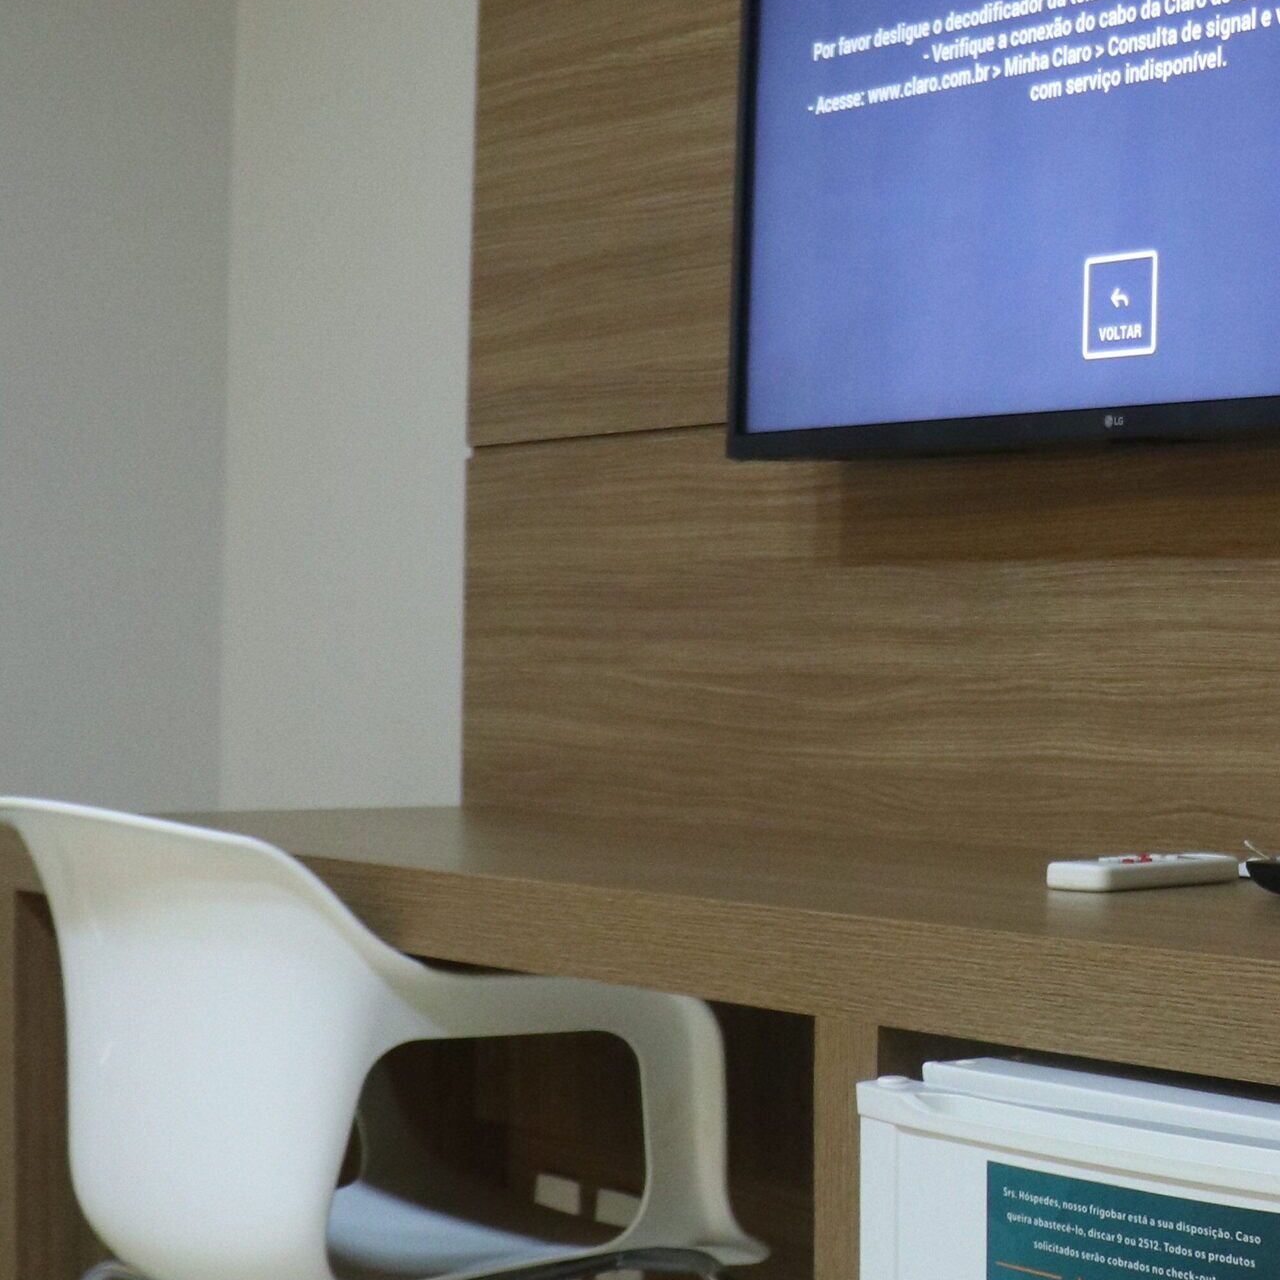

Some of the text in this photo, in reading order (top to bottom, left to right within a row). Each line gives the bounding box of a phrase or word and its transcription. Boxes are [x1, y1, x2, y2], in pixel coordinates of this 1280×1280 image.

[812, 41, 836, 61] Por
[836, 33, 872, 55] favor
[872, 20, 930, 47] desligue
[932, 18, 942, 34] o
[931, 36, 994, 62] Verifique
[997, 33, 1007, 48] a
[1010, 16, 1071, 46] conexão
[1075, 11, 1095, 32] do
[1098, 3, 1136, 28] cabo
[814, 90, 865, 114] Acesse:
[866, 62, 990, 104] www.claro.com.br
[1004, 51, 1049, 77] Minha
[1052, 45, 1091, 66] Claro
[1107, 26, 1177, 56] Consulta
[1181, 20, 1201, 42] de
[1205, 6, 1256, 40] signal
[1260, 9, 1271, 27] e
[1029, 44, 1226, 101] com serviço indisponível.
[1098, 323, 1141, 341] VOLTAR
[1113, 416, 1124, 426] LG
[1006, 1211, 1032, 1224] queira
[1087, 1227, 1115, 1241] discar
[1116, 1232, 1122, 1243] 9
[1123, 1236, 1136, 1246] ou
[1163, 1241, 1192, 1257] Todos
[1194, 1249, 1206, 1259] os
[1207, 1252, 1255, 1268] produtos
[1018, 1190, 1061, 1208] Hóspedes,
[1062, 1200, 1087, 1213] nosso
[1088, 1203, 1126, 1220] frigobar
[1127, 1213, 1147, 1224] está
[1149, 1217, 1155, 1226] a
[1157, 1219, 1174, 1229] sua
[1175, 1220, 1233, 1240] disposição.
[1235, 1230, 1261, 1244] Caso
[1033, 1240, 1079, 1258] solicitados
[1106, 1256, 1150, 1272] cobrados
[1151, 1265, 1164, 1275] no
